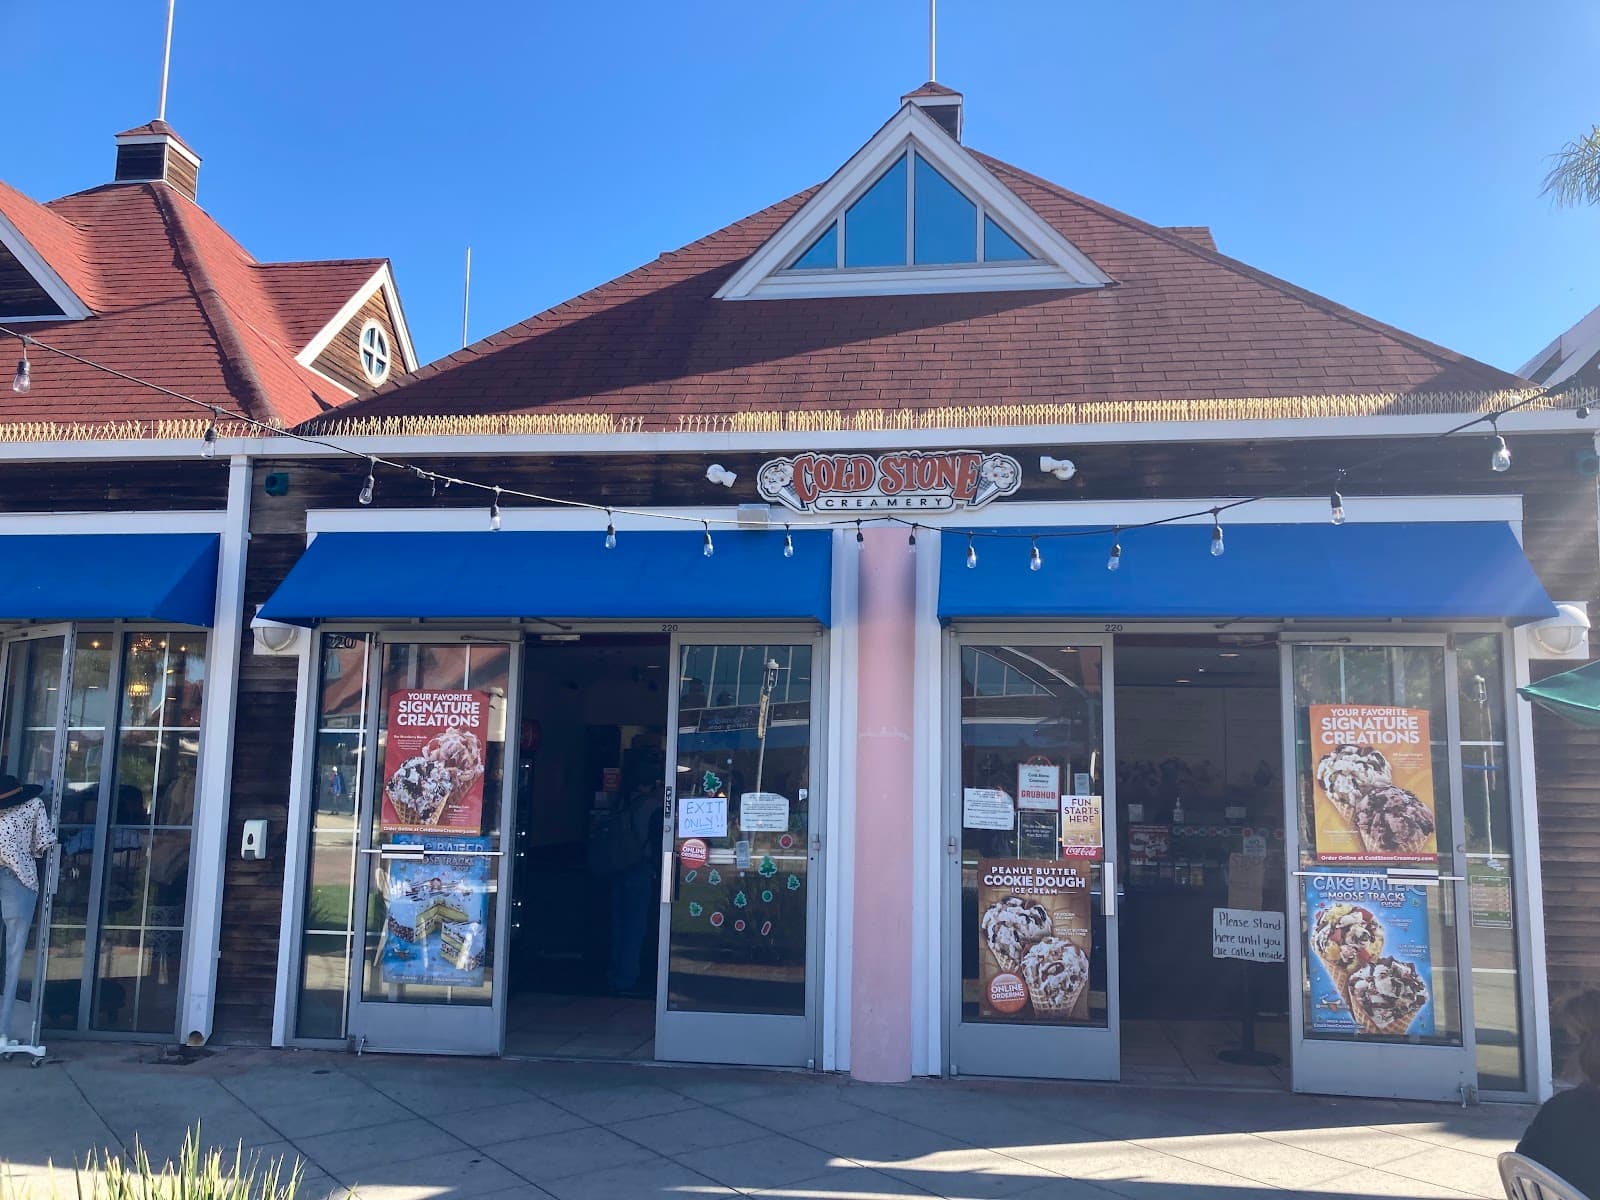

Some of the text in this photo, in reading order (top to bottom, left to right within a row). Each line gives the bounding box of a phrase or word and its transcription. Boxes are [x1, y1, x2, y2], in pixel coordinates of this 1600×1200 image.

[793, 454, 982, 502] COLD STONE
[825, 497, 942, 508] CREAMERY
[662, 624, 679, 632] 220
[1104, 623, 1124, 632] 220
[407, 692, 473, 702] YOUR FAVORITE
[398, 700, 480, 715] SIGNATURE
[1330, 708, 1408, 717] YOUR FAVORITE
[397, 713, 480, 728] CREATIONS
[1321, 716, 1419, 731] SIGNATURE
[1321, 730, 1420, 745] CREATIONS
[1021, 790, 1056, 800] GRUBHUB
[686, 801, 725, 814] EXIT
[1071, 798, 1092, 807] FUN
[1064, 806, 1099, 815] STARTS
[1069, 815, 1095, 824] HERE
[682, 846, 706, 854] ONLINE
[991, 866, 1077, 876] PEANUT BUTTER
[983, 874, 1086, 888] COOKIE DOUGH
[1367, 892, 1405, 902] TRACKS
[1219, 911, 1249, 928] Please
[1214, 928, 1281, 950] here until you
[1231, 947, 1255, 957] called
[1258, 951, 1283, 960] inside
[991, 983, 1024, 993] ONLINE
